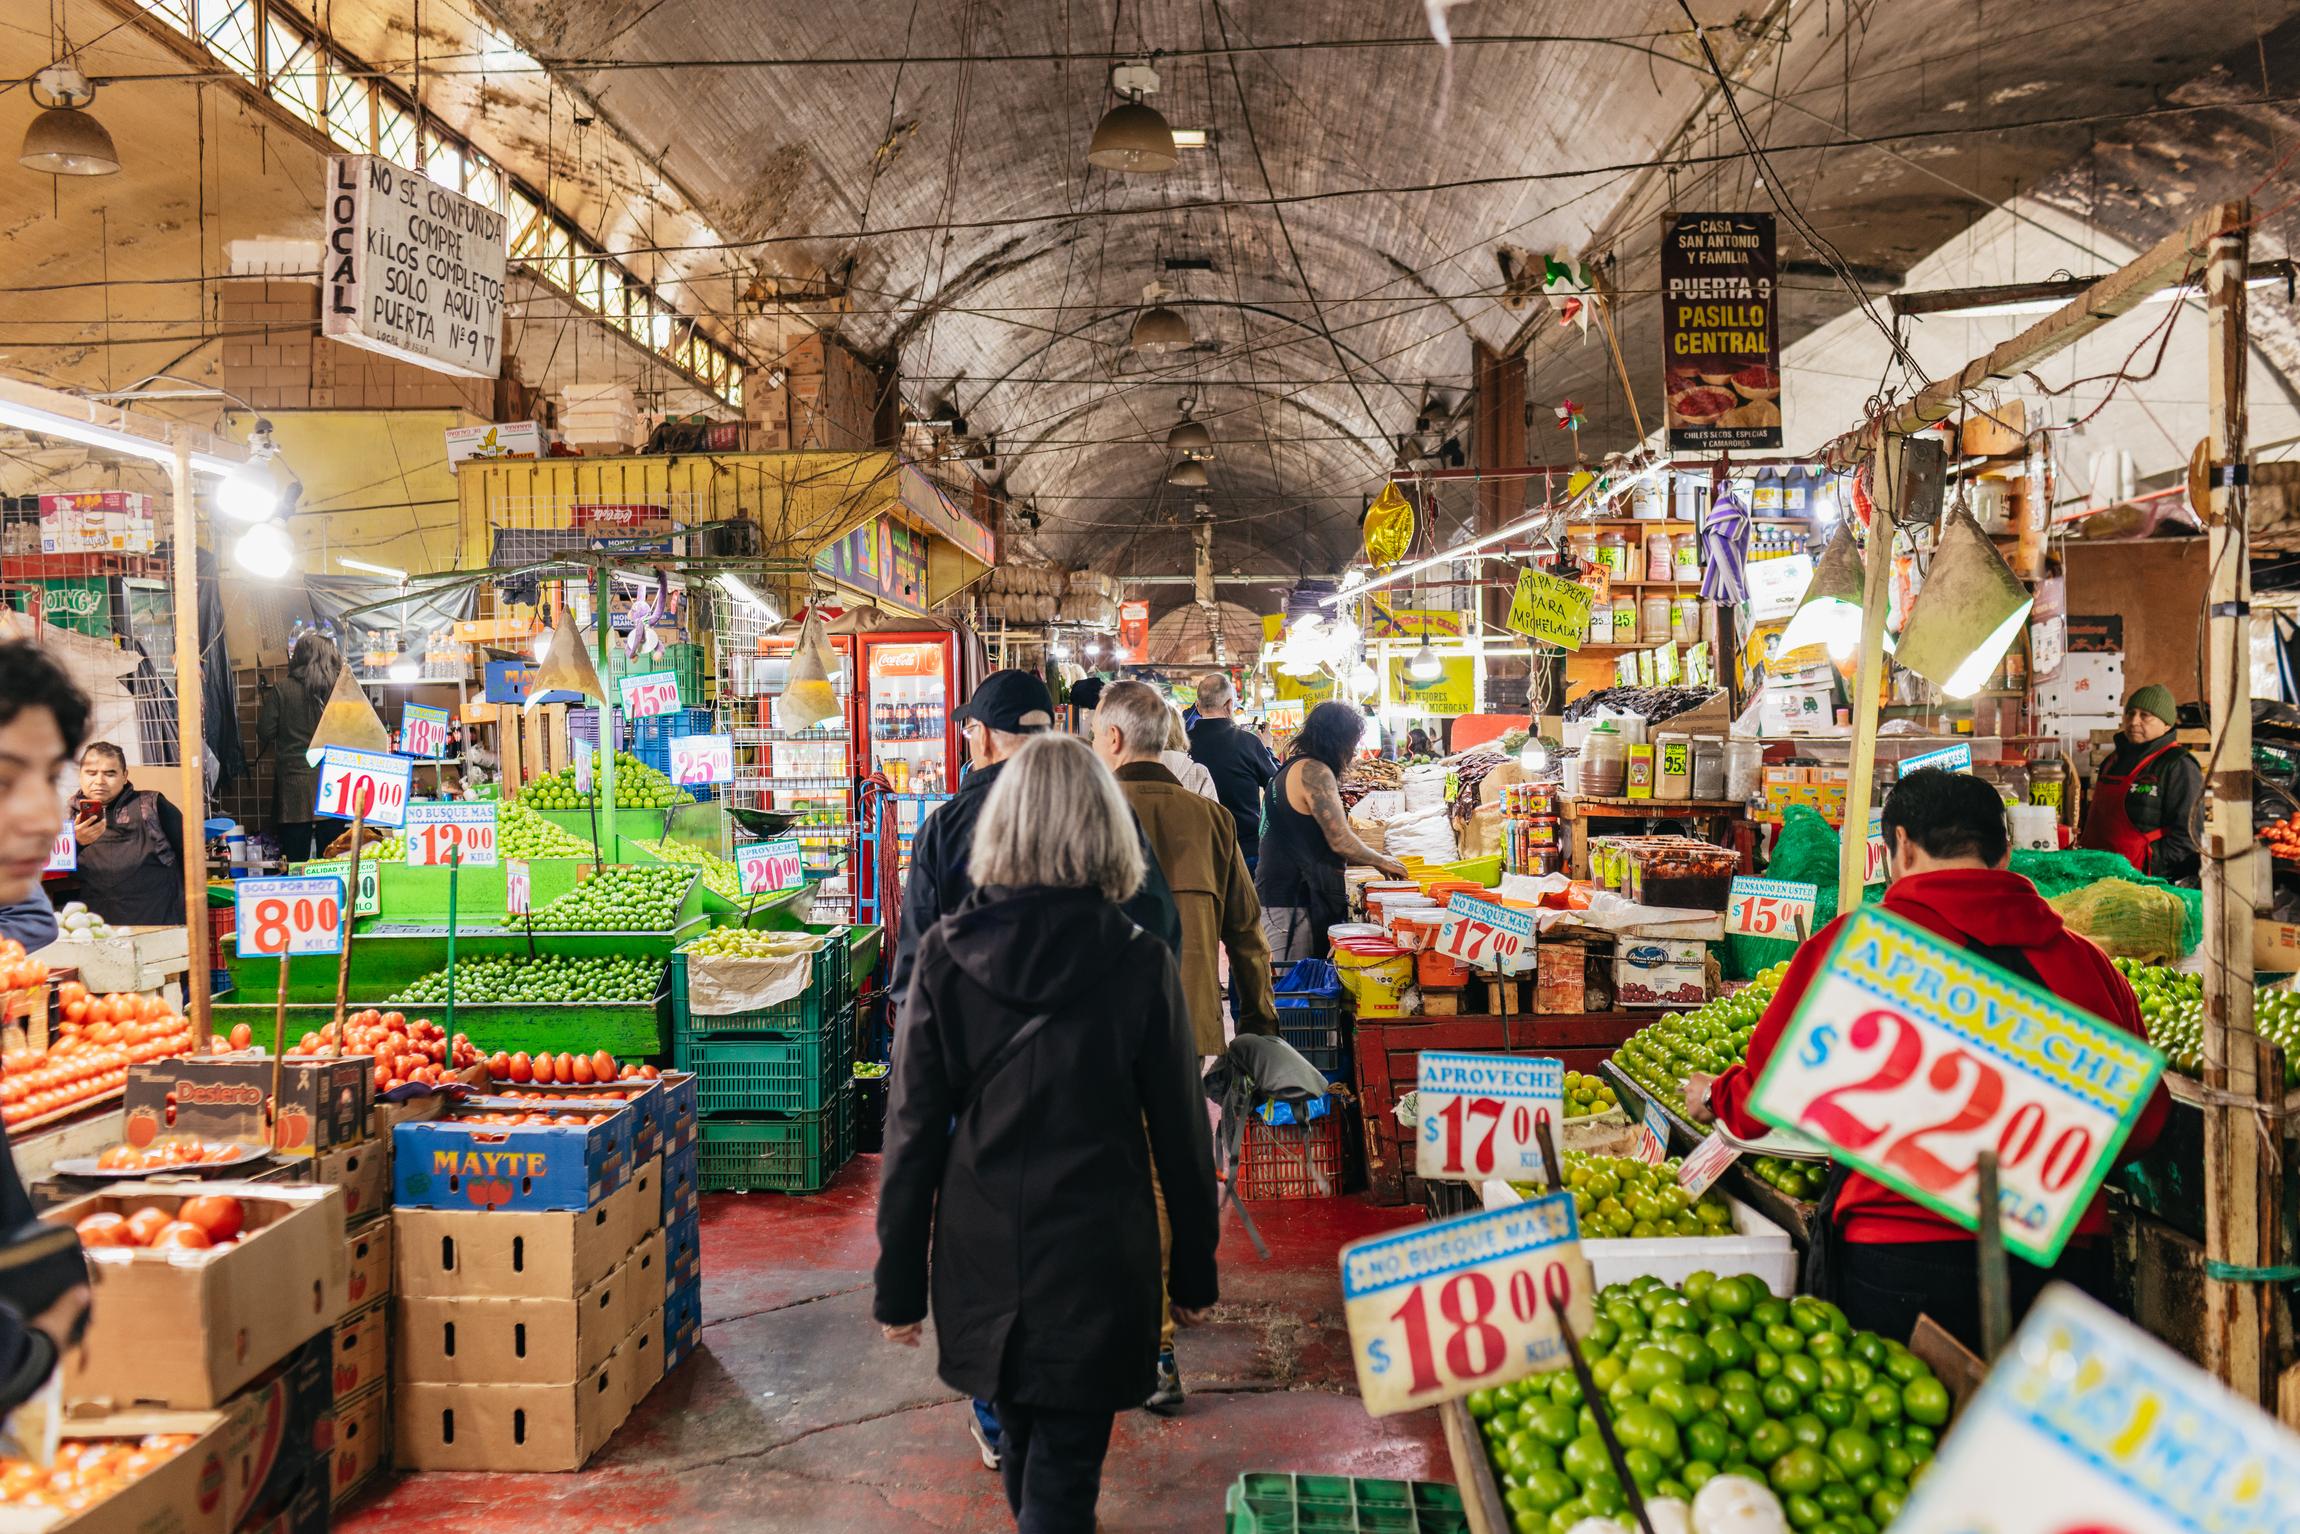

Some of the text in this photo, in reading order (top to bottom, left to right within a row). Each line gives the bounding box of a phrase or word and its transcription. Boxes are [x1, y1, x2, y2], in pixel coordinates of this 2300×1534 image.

[370, 160, 501, 247] NO SE CONFUNDA
[331, 159, 357, 315] LOCAL
[408, 214, 463, 261] COMPRE
[1700, 220, 1732, 234] CASA
[1678, 234, 1760, 249] SAN ANTONIO
[1687, 251, 1749, 265] Y FAMILIA
[385, 266, 428, 304] SOLO
[426, 254, 505, 304] COMPLETOS
[1669, 277, 1771, 300] PUERTA 9
[373, 295, 435, 343] PUERTA
[1678, 305, 1764, 328] PASILLO
[376, 330, 399, 346] LOCAL
[1674, 331, 1770, 355] CENTRAL
[1684, 431, 1709, 440] CHILES
[1736, 429, 1768, 439] ESPECIAS
[1702, 439, 1751, 448] Y CAMARONES
[1531, 594, 1567, 620] PARA
[1415, 691, 1448, 702] MEJORES
[408, 807, 494, 820] NO BUSQUE MAS
[470, 852, 493, 862] KILO
[738, 841, 799, 857] APROVECHE
[306, 867, 338, 875] CALIDAD
[243, 880, 333, 893] SOLO POR HOY
[1735, 881, 1814, 896] PENSANDO EN USTED
[1451, 897, 1530, 930] NO BUSQUE MAS
[1850, 938, 2140, 1094] APROVECHE
[1424, 1066, 1557, 1089] APROVECHE
[176, 1081, 263, 1105] Desierto
[433, 1151, 548, 1177] MAYTE
[1369, 1215, 1551, 1275] NO BUSQUE MAS
